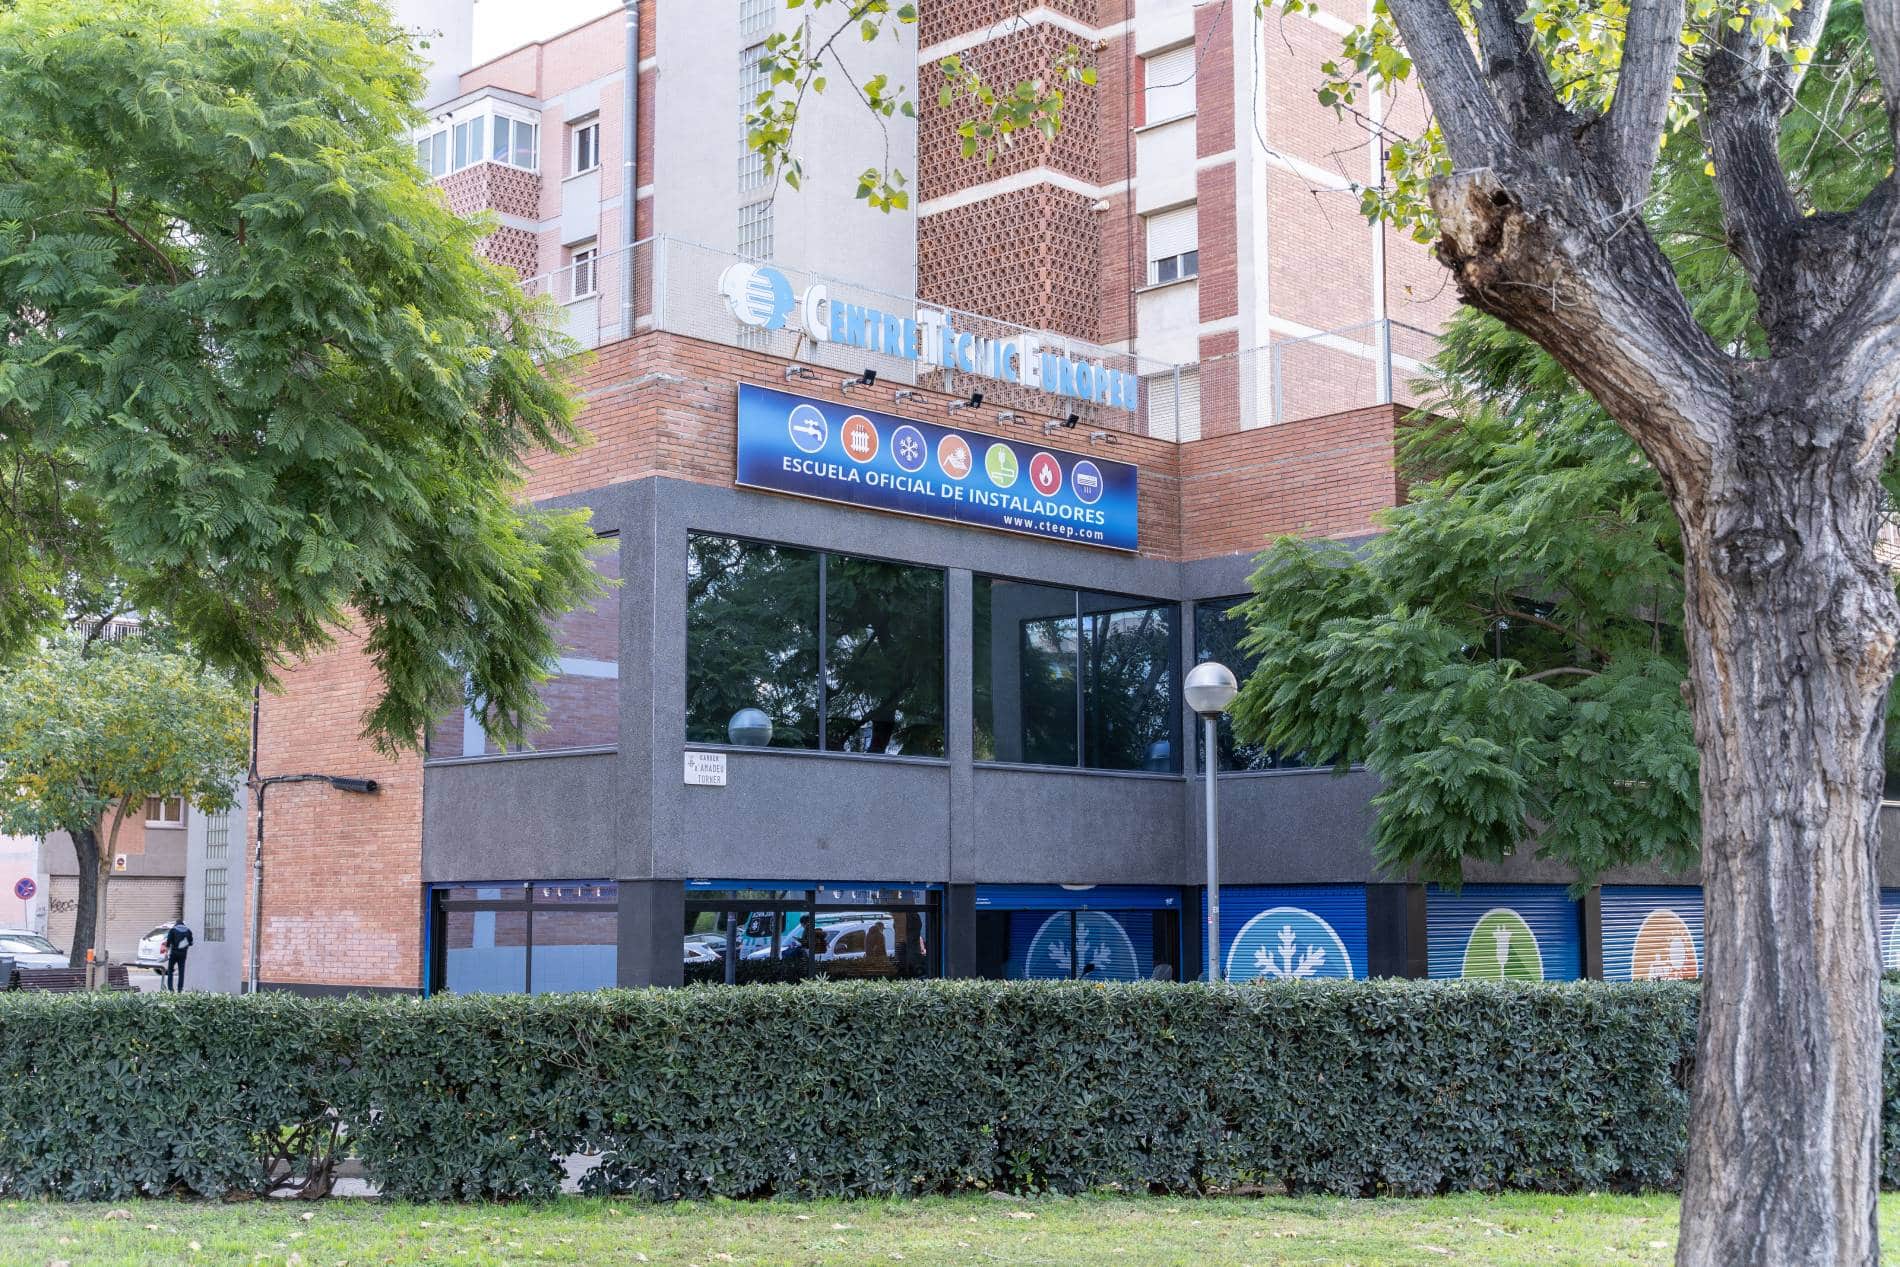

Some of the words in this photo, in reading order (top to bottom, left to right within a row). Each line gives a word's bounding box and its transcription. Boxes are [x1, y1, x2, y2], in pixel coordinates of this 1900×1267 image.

[782, 456, 861, 483] ESCUELA
[865, 471, 936, 496] OFICIAL
[941, 483, 964, 501] DE
[969, 489, 1105, 525] INSTALADORES
[1003, 515, 1104, 540] www.cteep.com
[698, 774, 721, 784] TORNER
